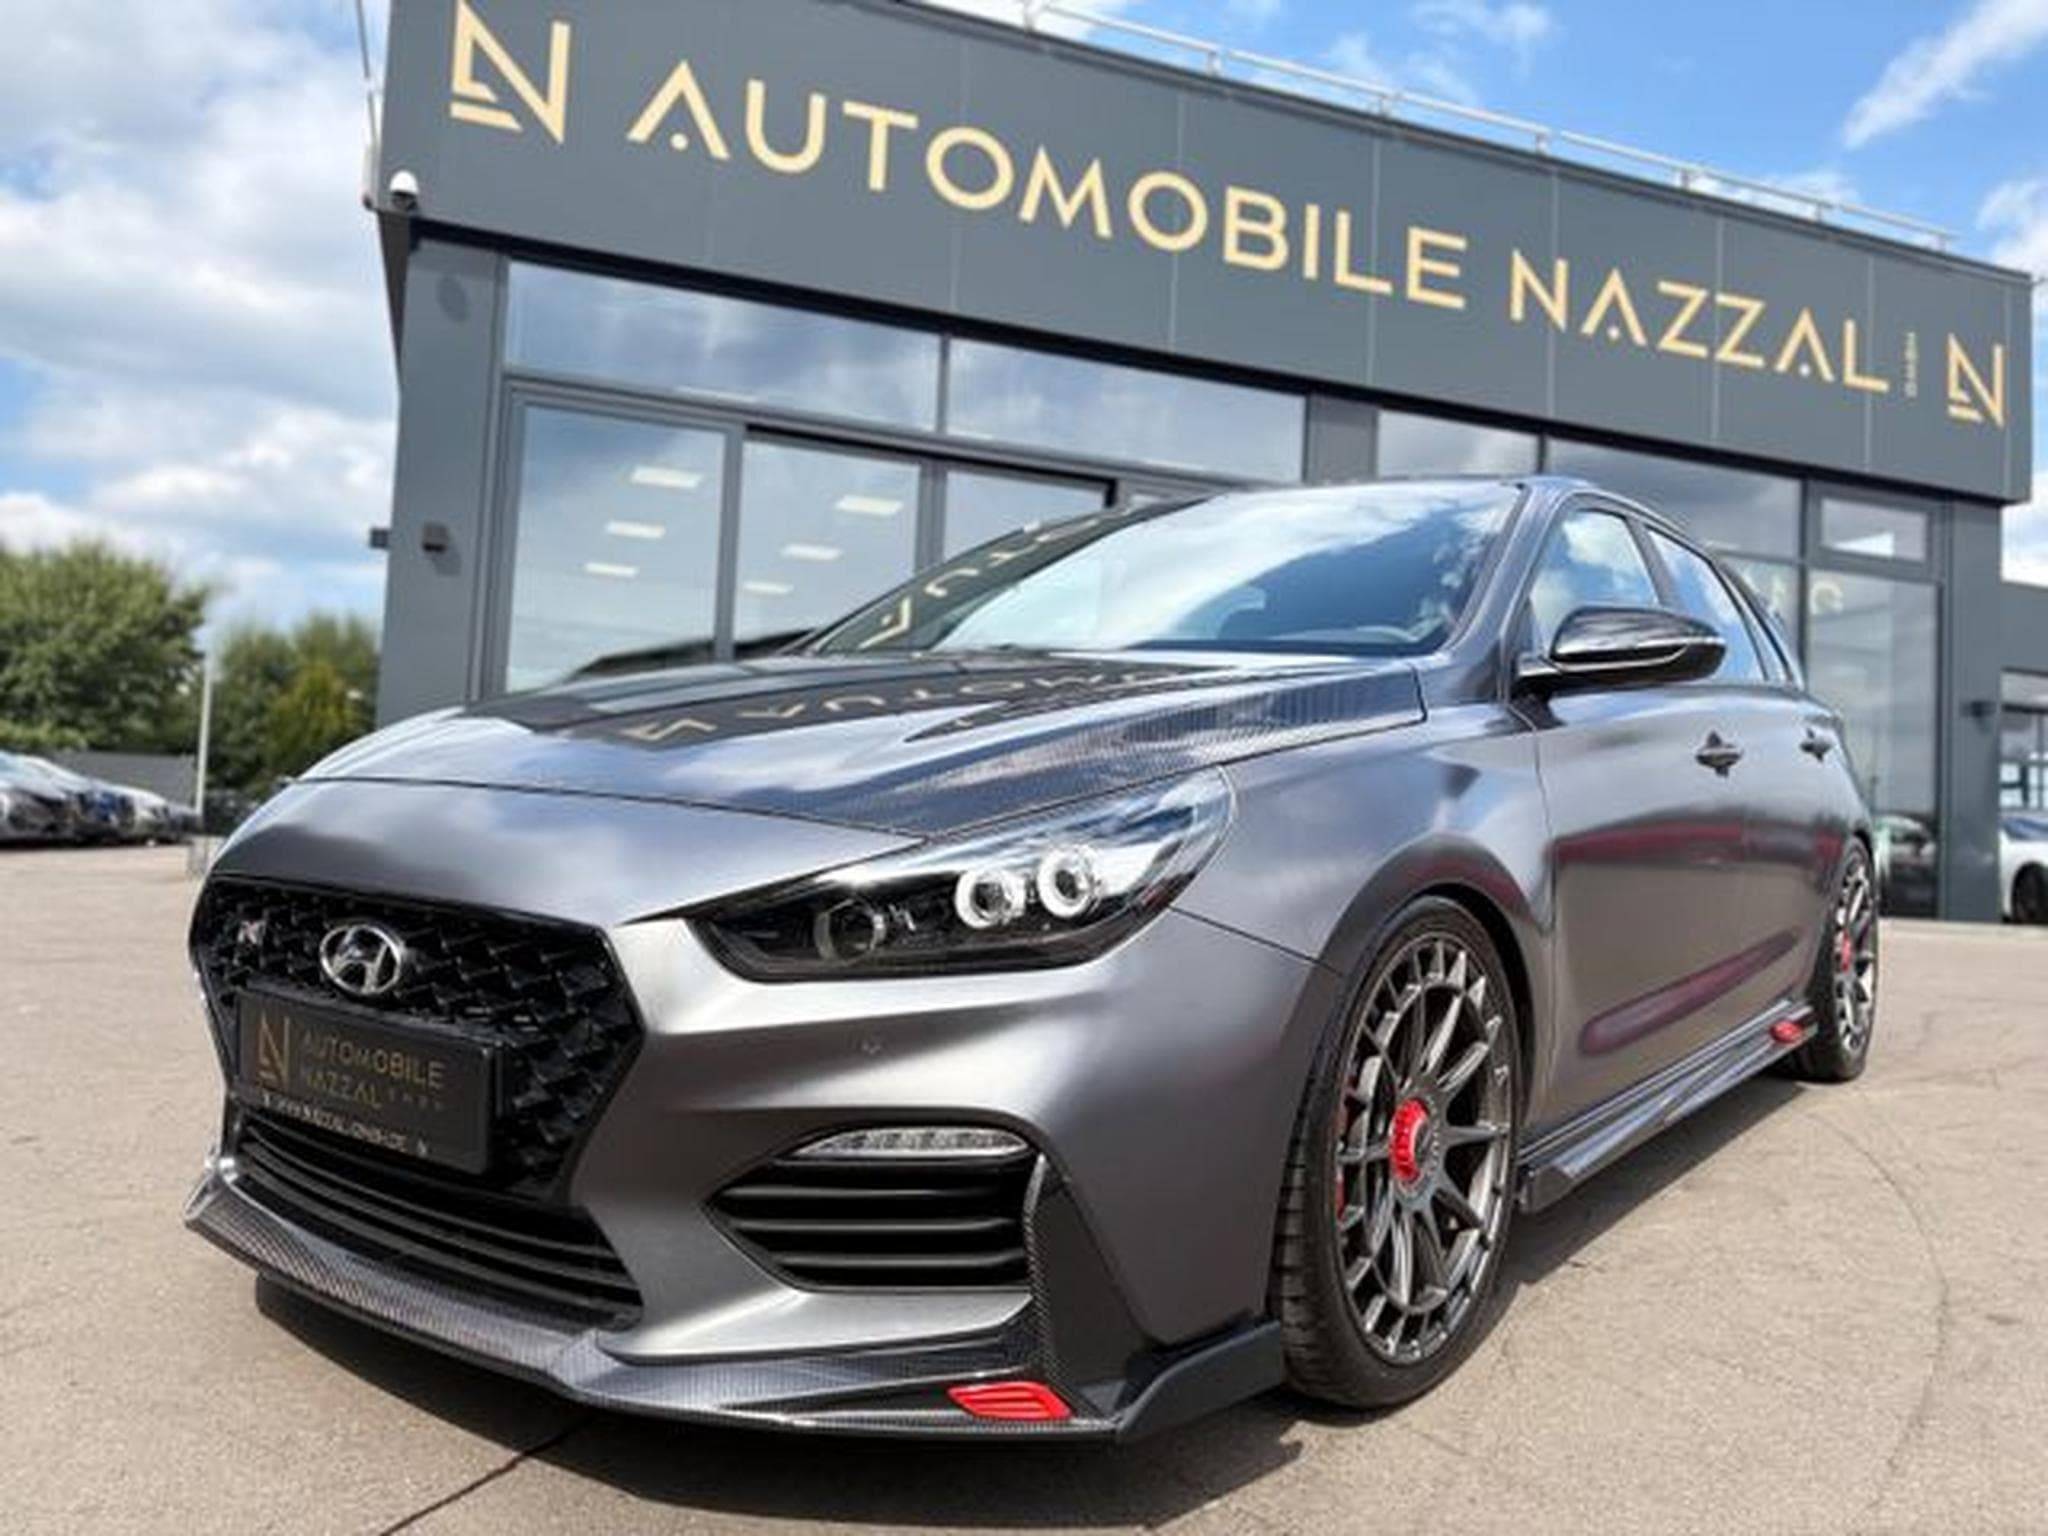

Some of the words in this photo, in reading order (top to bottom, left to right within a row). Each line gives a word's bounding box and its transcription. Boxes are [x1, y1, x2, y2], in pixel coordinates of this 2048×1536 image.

[627, 60, 1468, 311] AUTOMOBILE
[1509, 249, 1889, 394] NAZZAL
[303, 1028, 446, 1093] AUTOMOBILE
